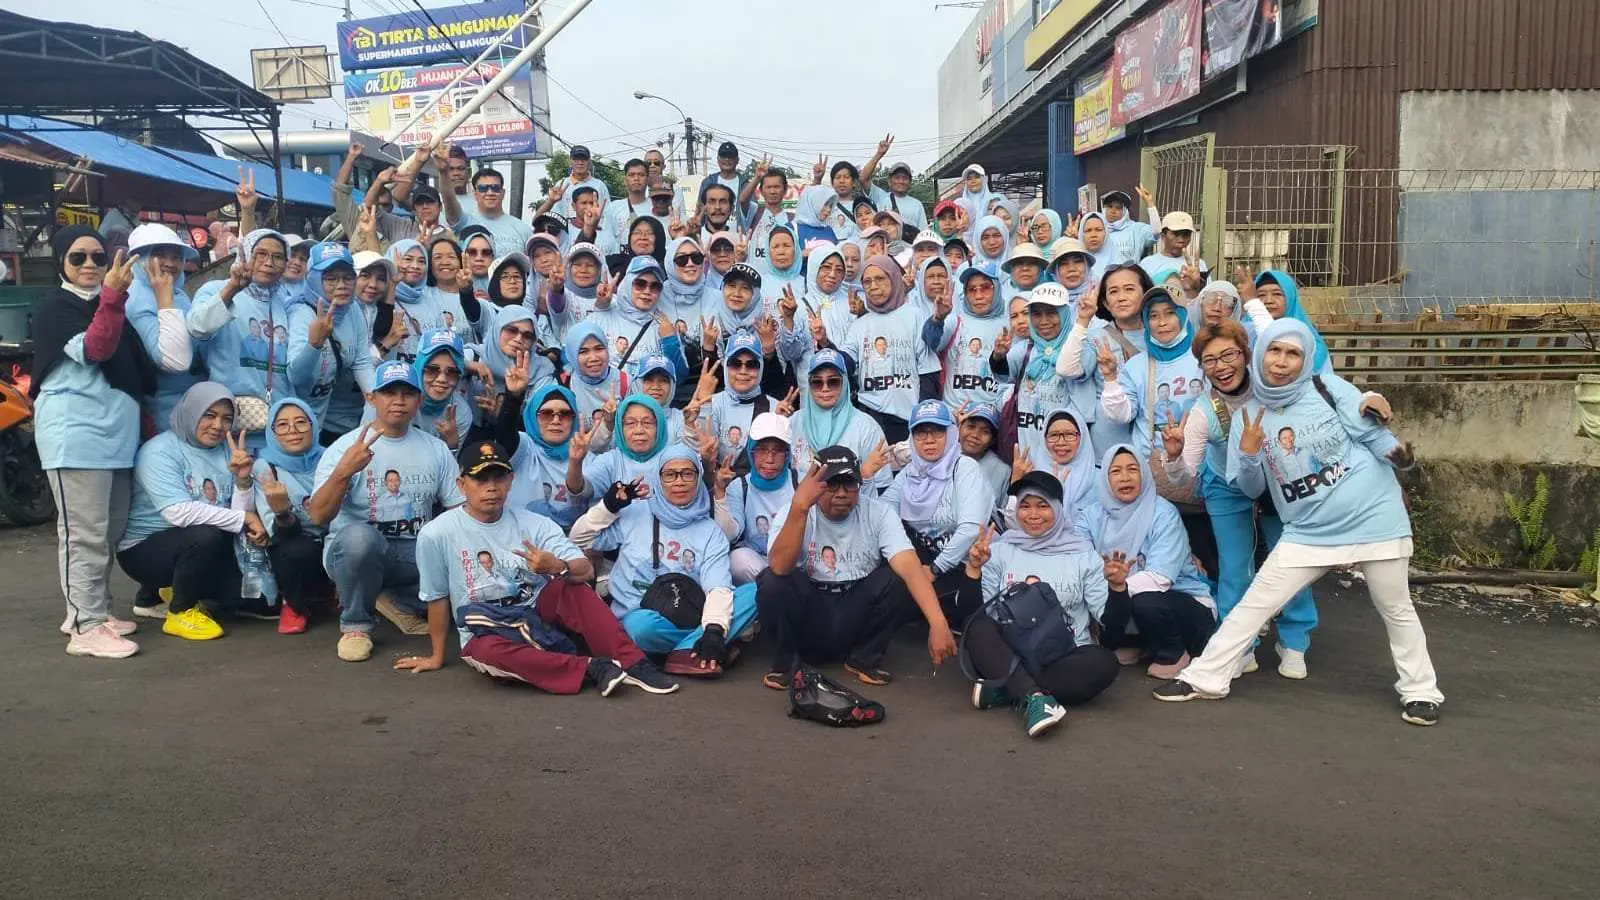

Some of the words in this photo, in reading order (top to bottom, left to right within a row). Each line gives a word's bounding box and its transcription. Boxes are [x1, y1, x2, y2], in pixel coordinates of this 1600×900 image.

[379, 28, 425, 45] TIRTA
[428, 14, 521, 40] BANGUNAN
[358, 46, 425, 62] SUPERMARKET
[421, 70, 451, 83] HUJAN
[1173, 376, 1187, 396] 2
[554, 483, 568, 502] 2
[667, 540, 681, 561] 2
